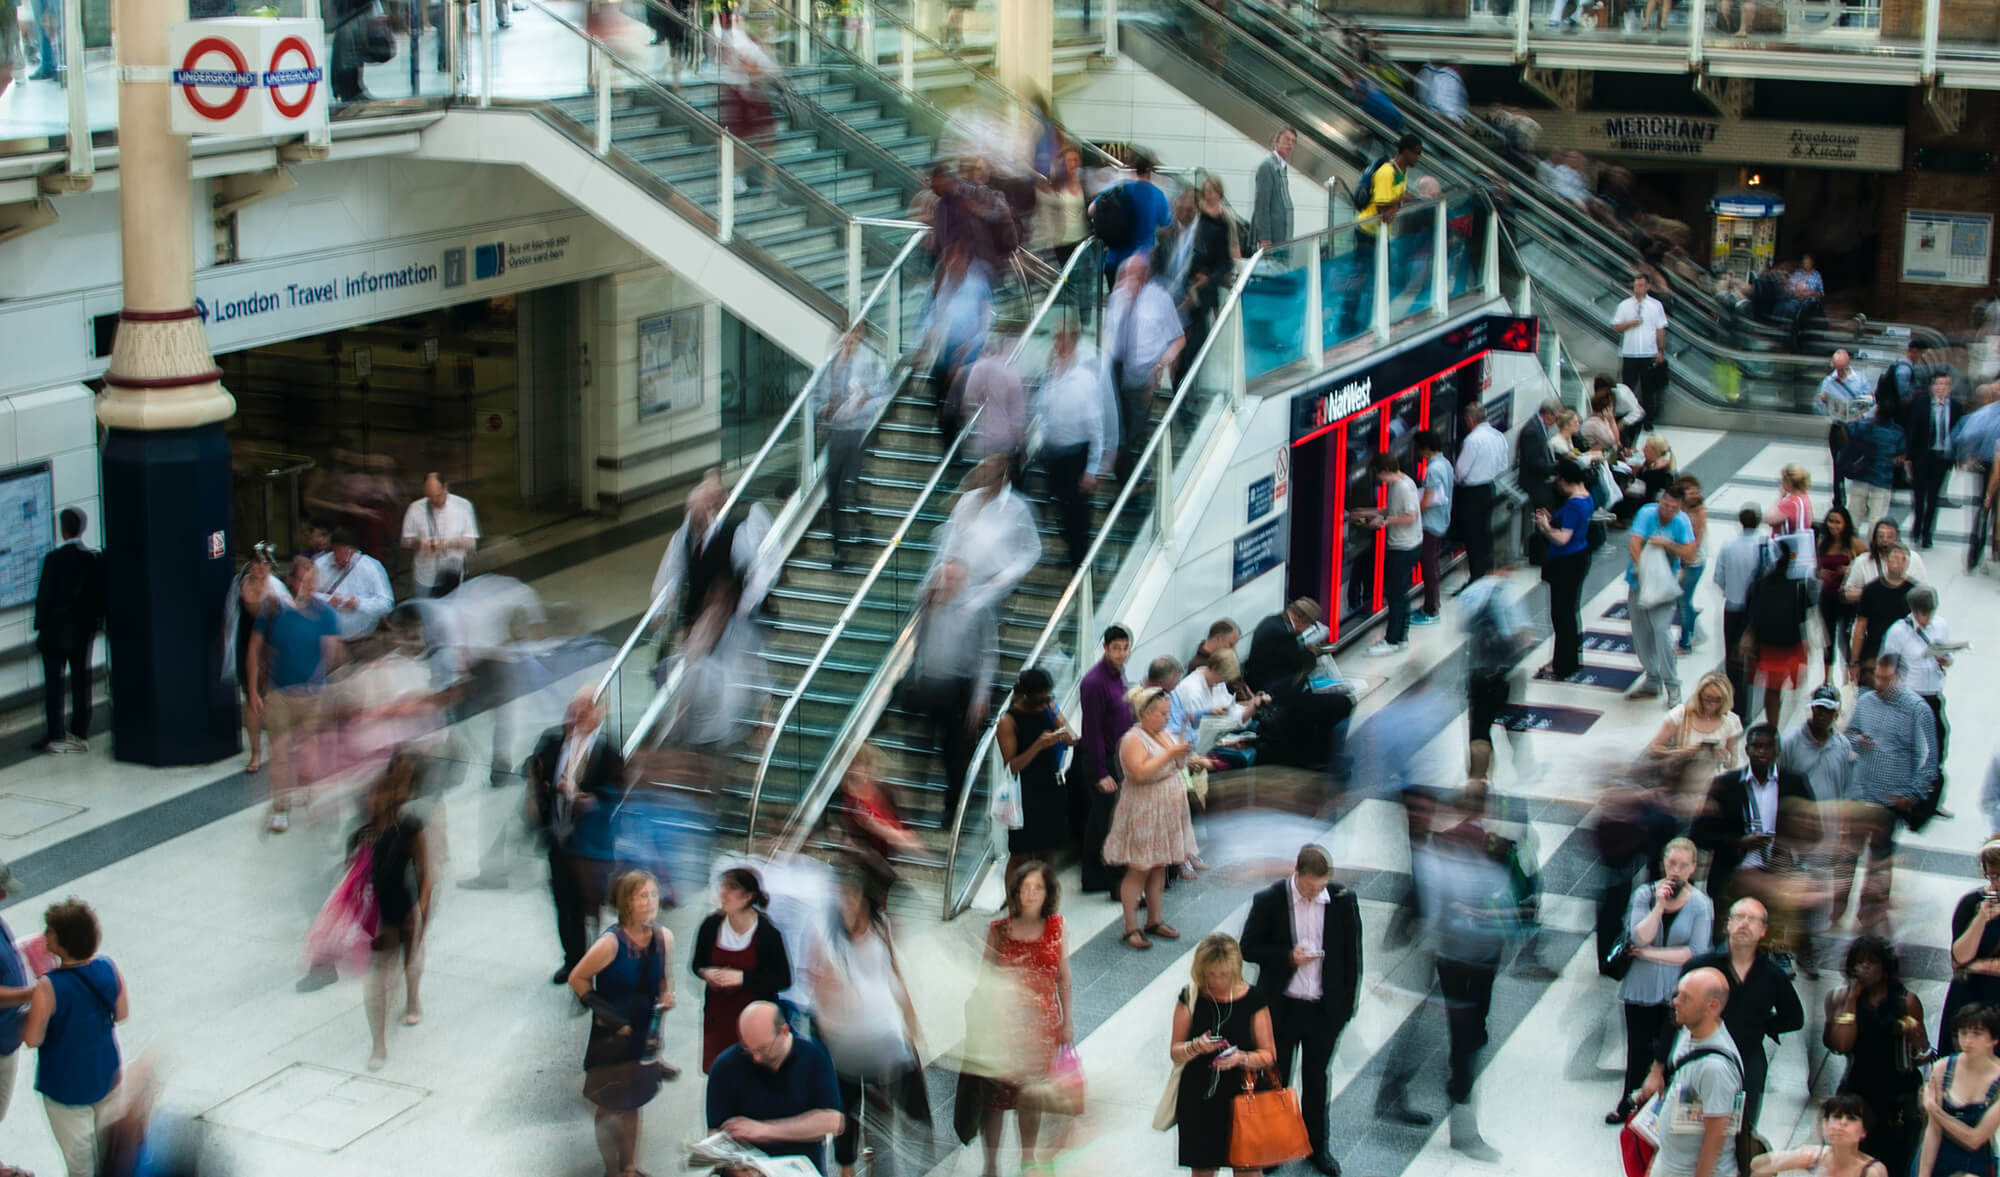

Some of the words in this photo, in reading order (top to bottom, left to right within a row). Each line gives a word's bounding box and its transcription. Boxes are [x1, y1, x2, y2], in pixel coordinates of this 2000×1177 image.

[178, 71, 253, 83] UNDERGROUND
[266, 69, 320, 84] UNDERGROUND
[1606, 117, 1720, 142] MERCHANT
[1792, 129, 1859, 144] Freehouse
[1620, 138, 1703, 153] BISHOPSGATE
[1808, 143, 1857, 158] Kitchen
[215, 291, 279, 323] London
[287, 278, 338, 307] Travel
[346, 263, 438, 297] Information
[1328, 376, 1372, 423] NatWest
